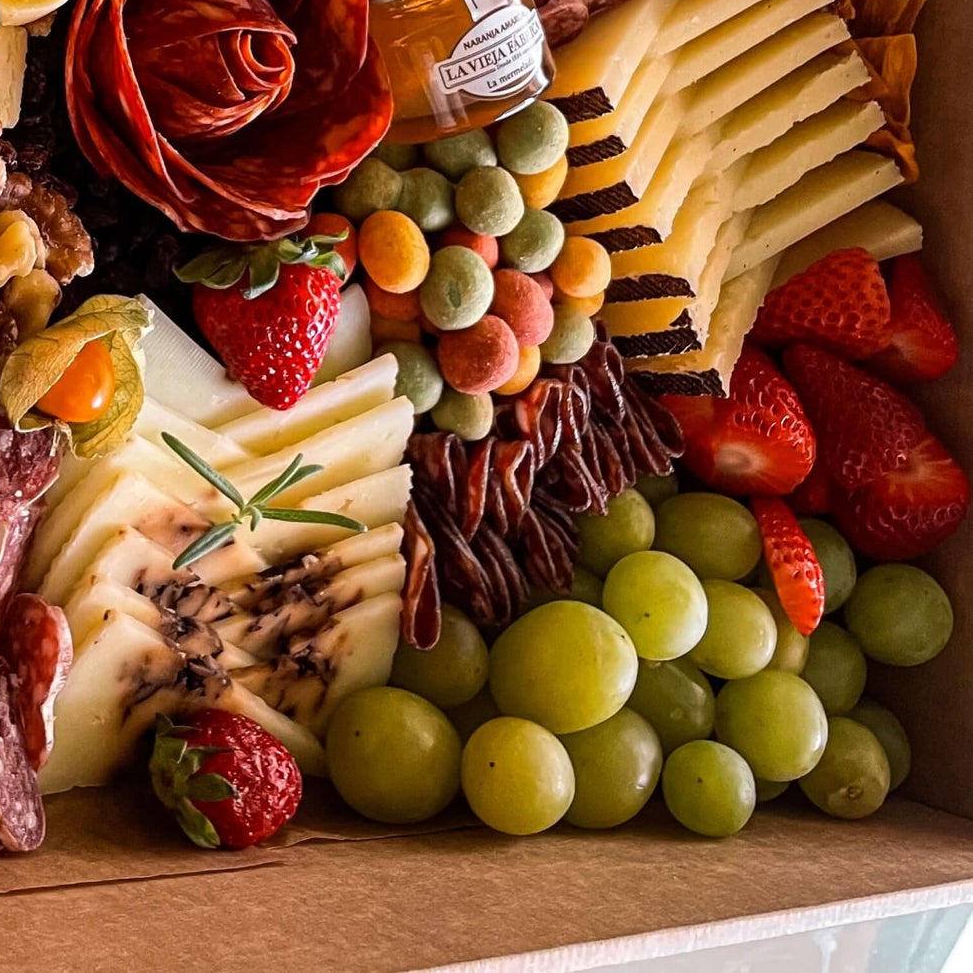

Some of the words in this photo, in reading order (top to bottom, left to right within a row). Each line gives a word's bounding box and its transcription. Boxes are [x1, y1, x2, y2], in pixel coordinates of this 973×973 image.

[463, 27, 500, 50] NARANJA
[444, 65, 469, 82] LA
[466, 47, 506, 72] VIEJA
[506, 21, 540, 55] FÁBICA
[487, 80, 498, 89] La
